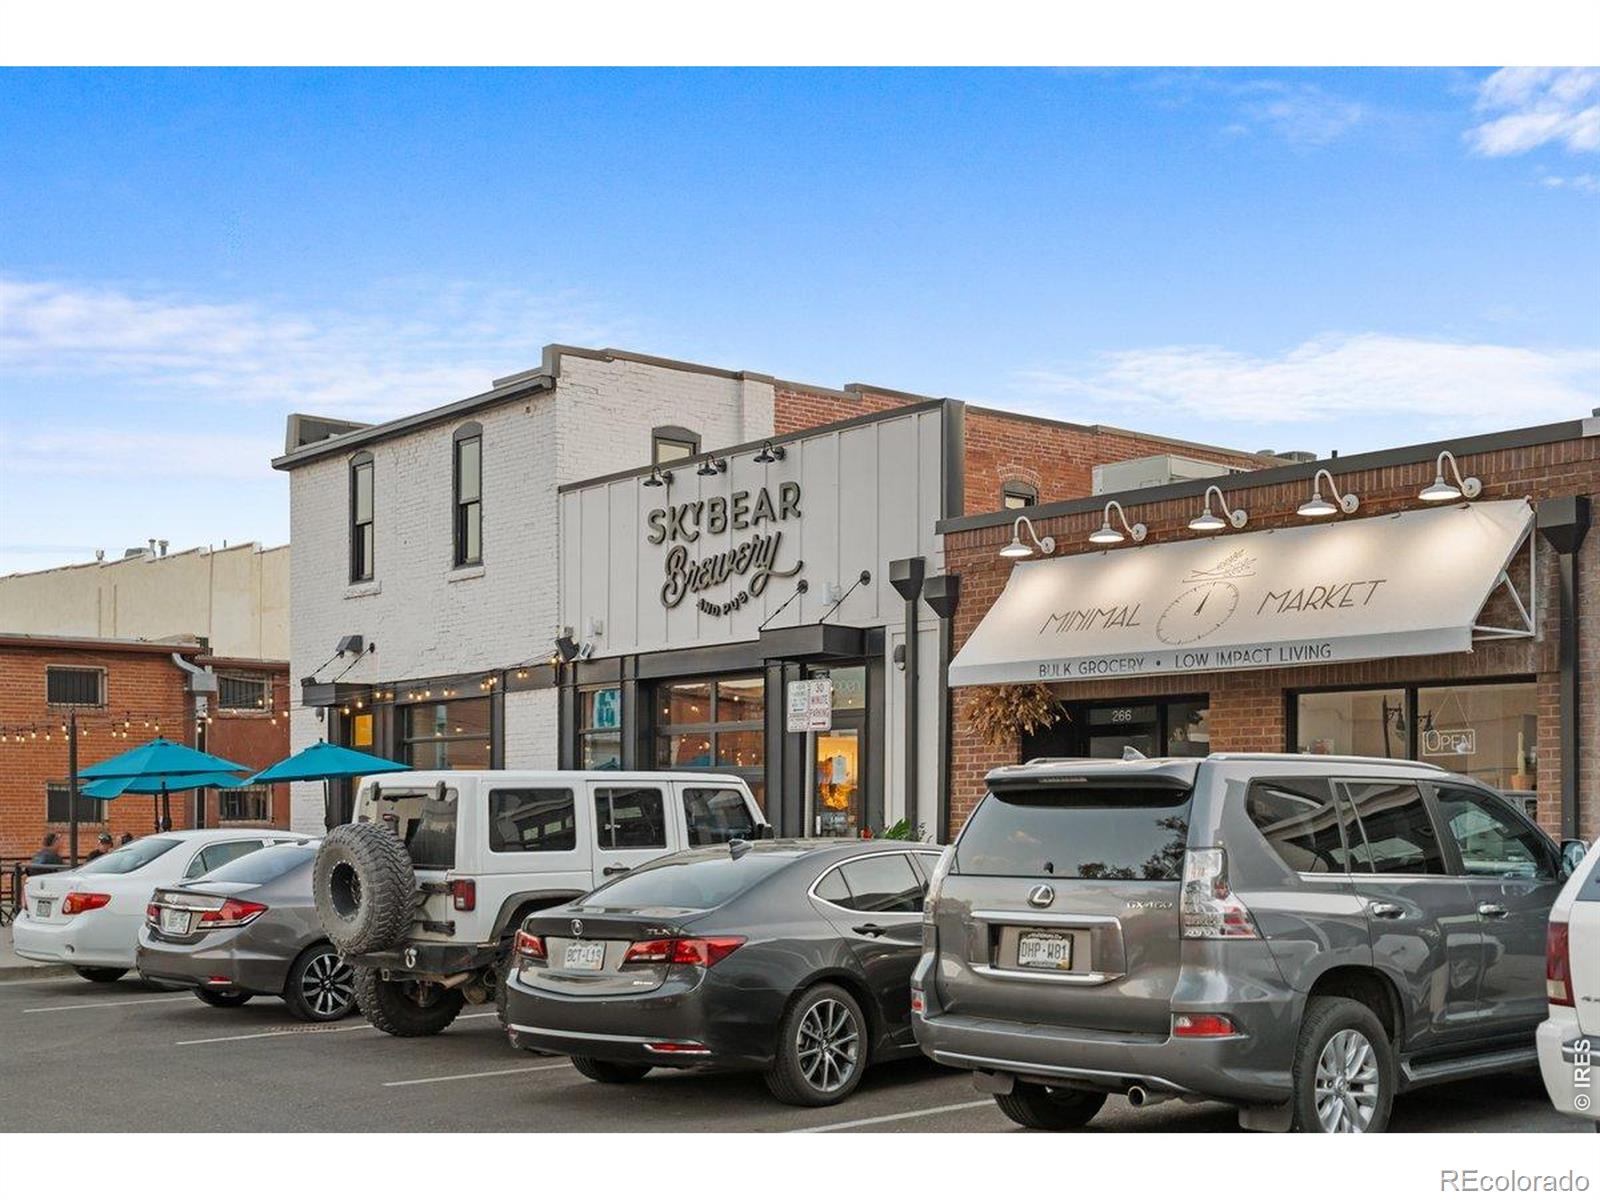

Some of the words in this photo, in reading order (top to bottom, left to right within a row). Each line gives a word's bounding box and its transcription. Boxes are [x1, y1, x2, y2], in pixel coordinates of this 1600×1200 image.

[647, 481, 802, 545] SKYBEAR
[696, 598, 721, 617] AND
[722, 591, 749, 616] PUB
[1038, 603, 1142, 635] MINIMAL
[1256, 579, 1388, 615] MARKET
[1038, 662, 1073, 679] BULK
[1078, 657, 1145, 676] GROCERY
[1174, 652, 1209, 670] LOW
[1215, 647, 1273, 666] IMPACT
[1278, 643, 1332, 663] LIVING
[1112, 709, 1132, 722] 266
